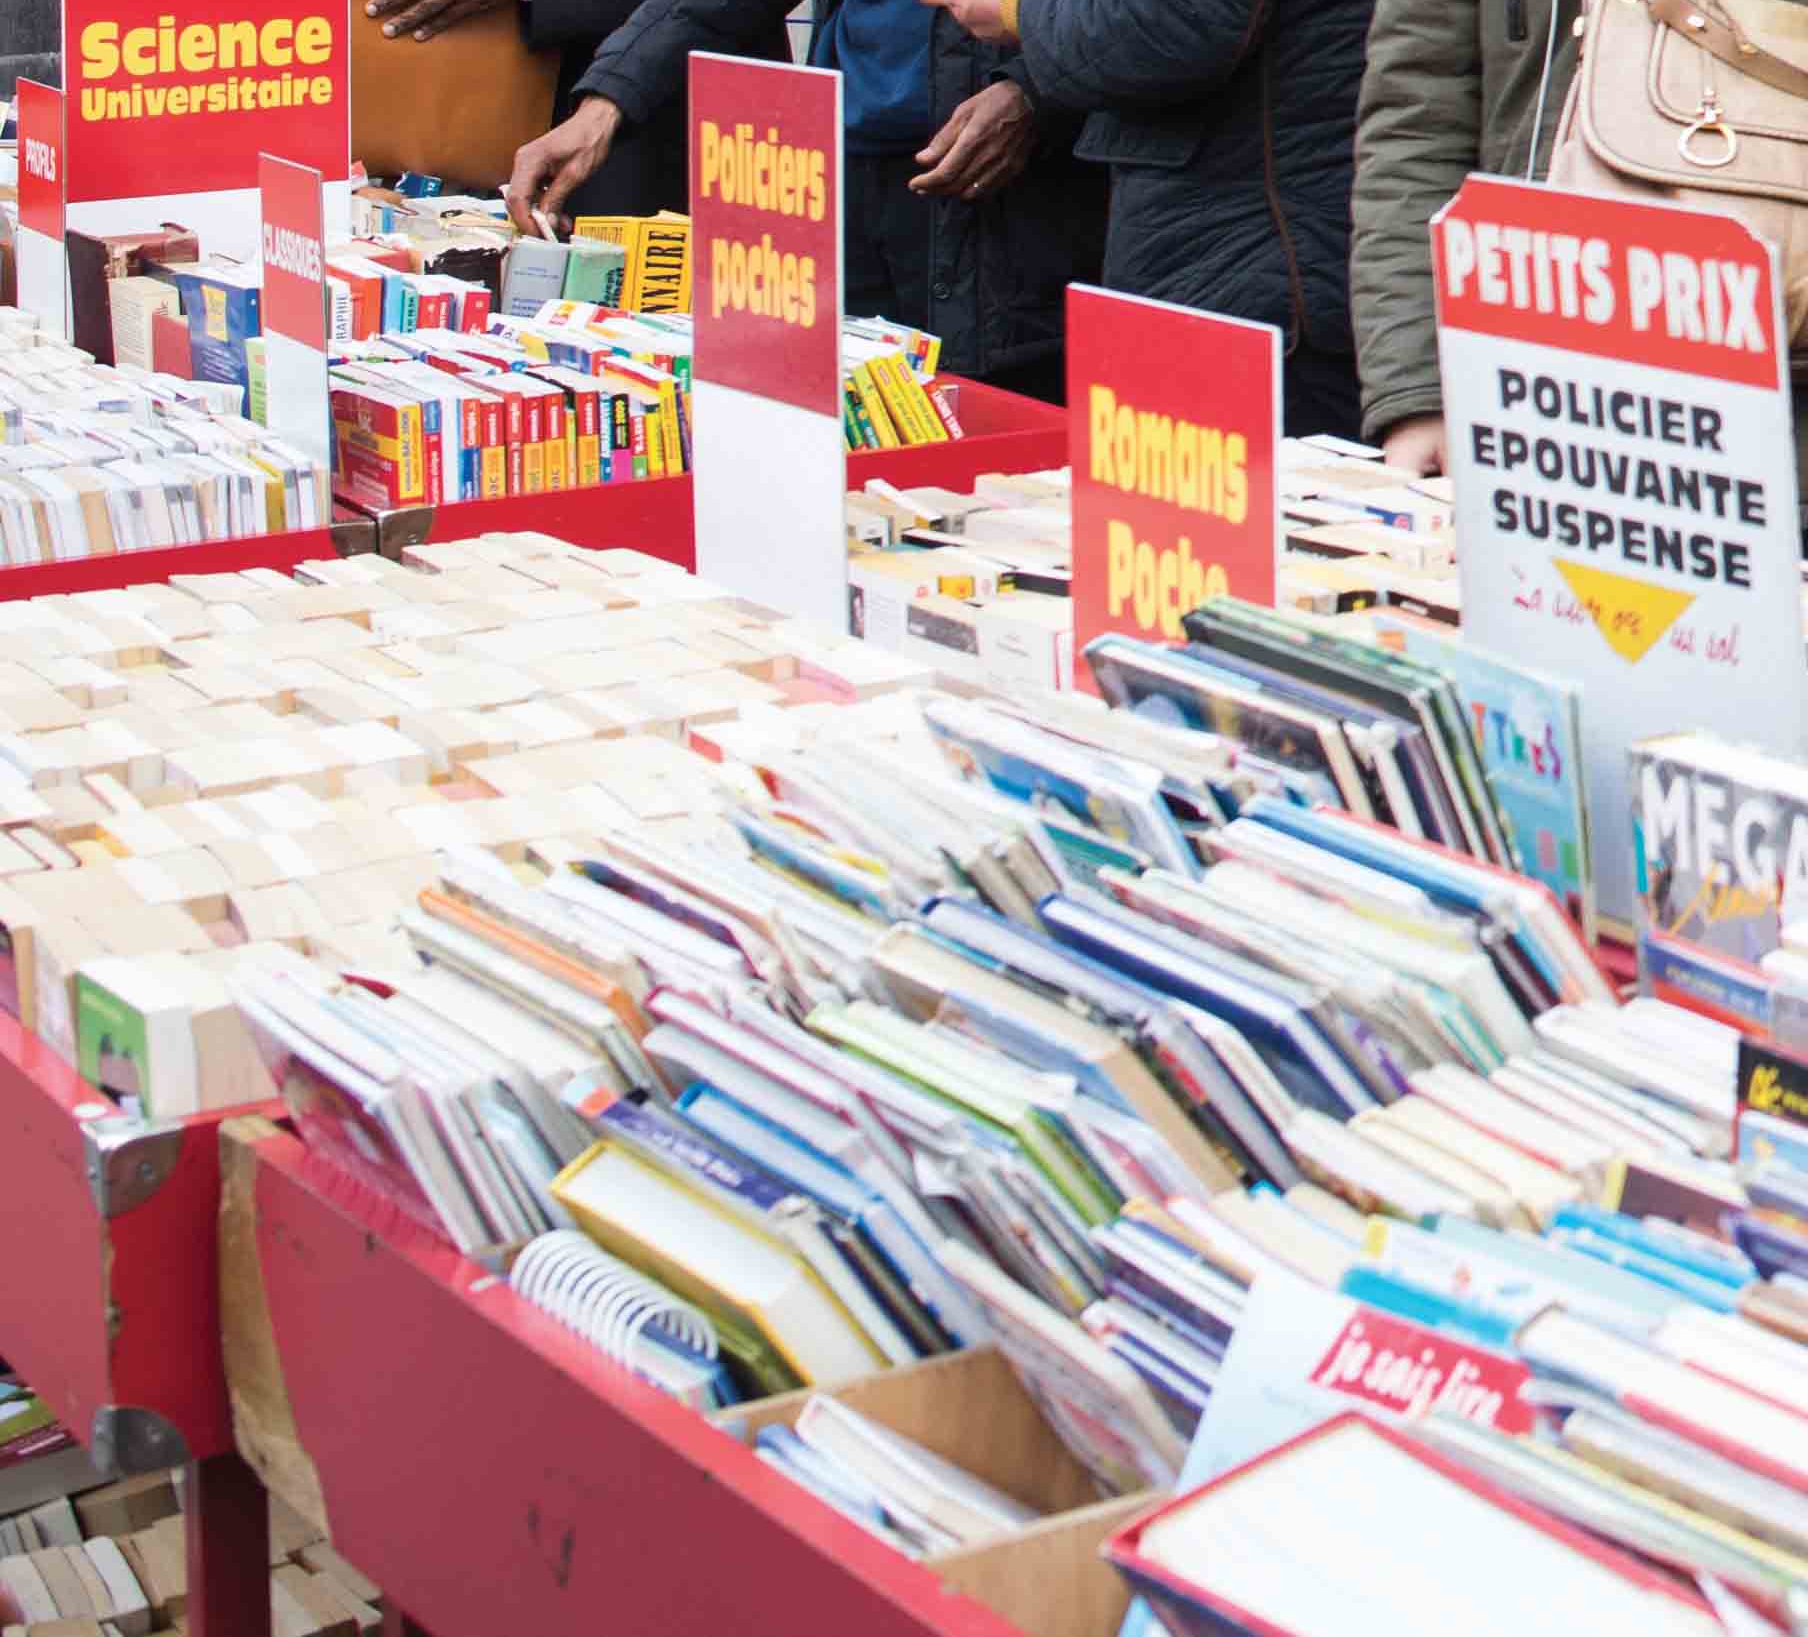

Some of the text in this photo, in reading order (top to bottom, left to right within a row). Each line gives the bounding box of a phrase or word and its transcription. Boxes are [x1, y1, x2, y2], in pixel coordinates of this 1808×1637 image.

[80, 15, 333, 80] Science
[81, 74, 333, 122] Universitaire
[699, 120, 827, 224] Policiers
[710, 233, 817, 329] poches
[1443, 218, 1767, 356] PETITS PRIX
[1089, 382, 1249, 527] Romans
[1497, 367, 1724, 453] POLICIER
[1470, 423, 1768, 528] EPOUVANTE
[1493, 488, 1754, 589] SUSPENSE
